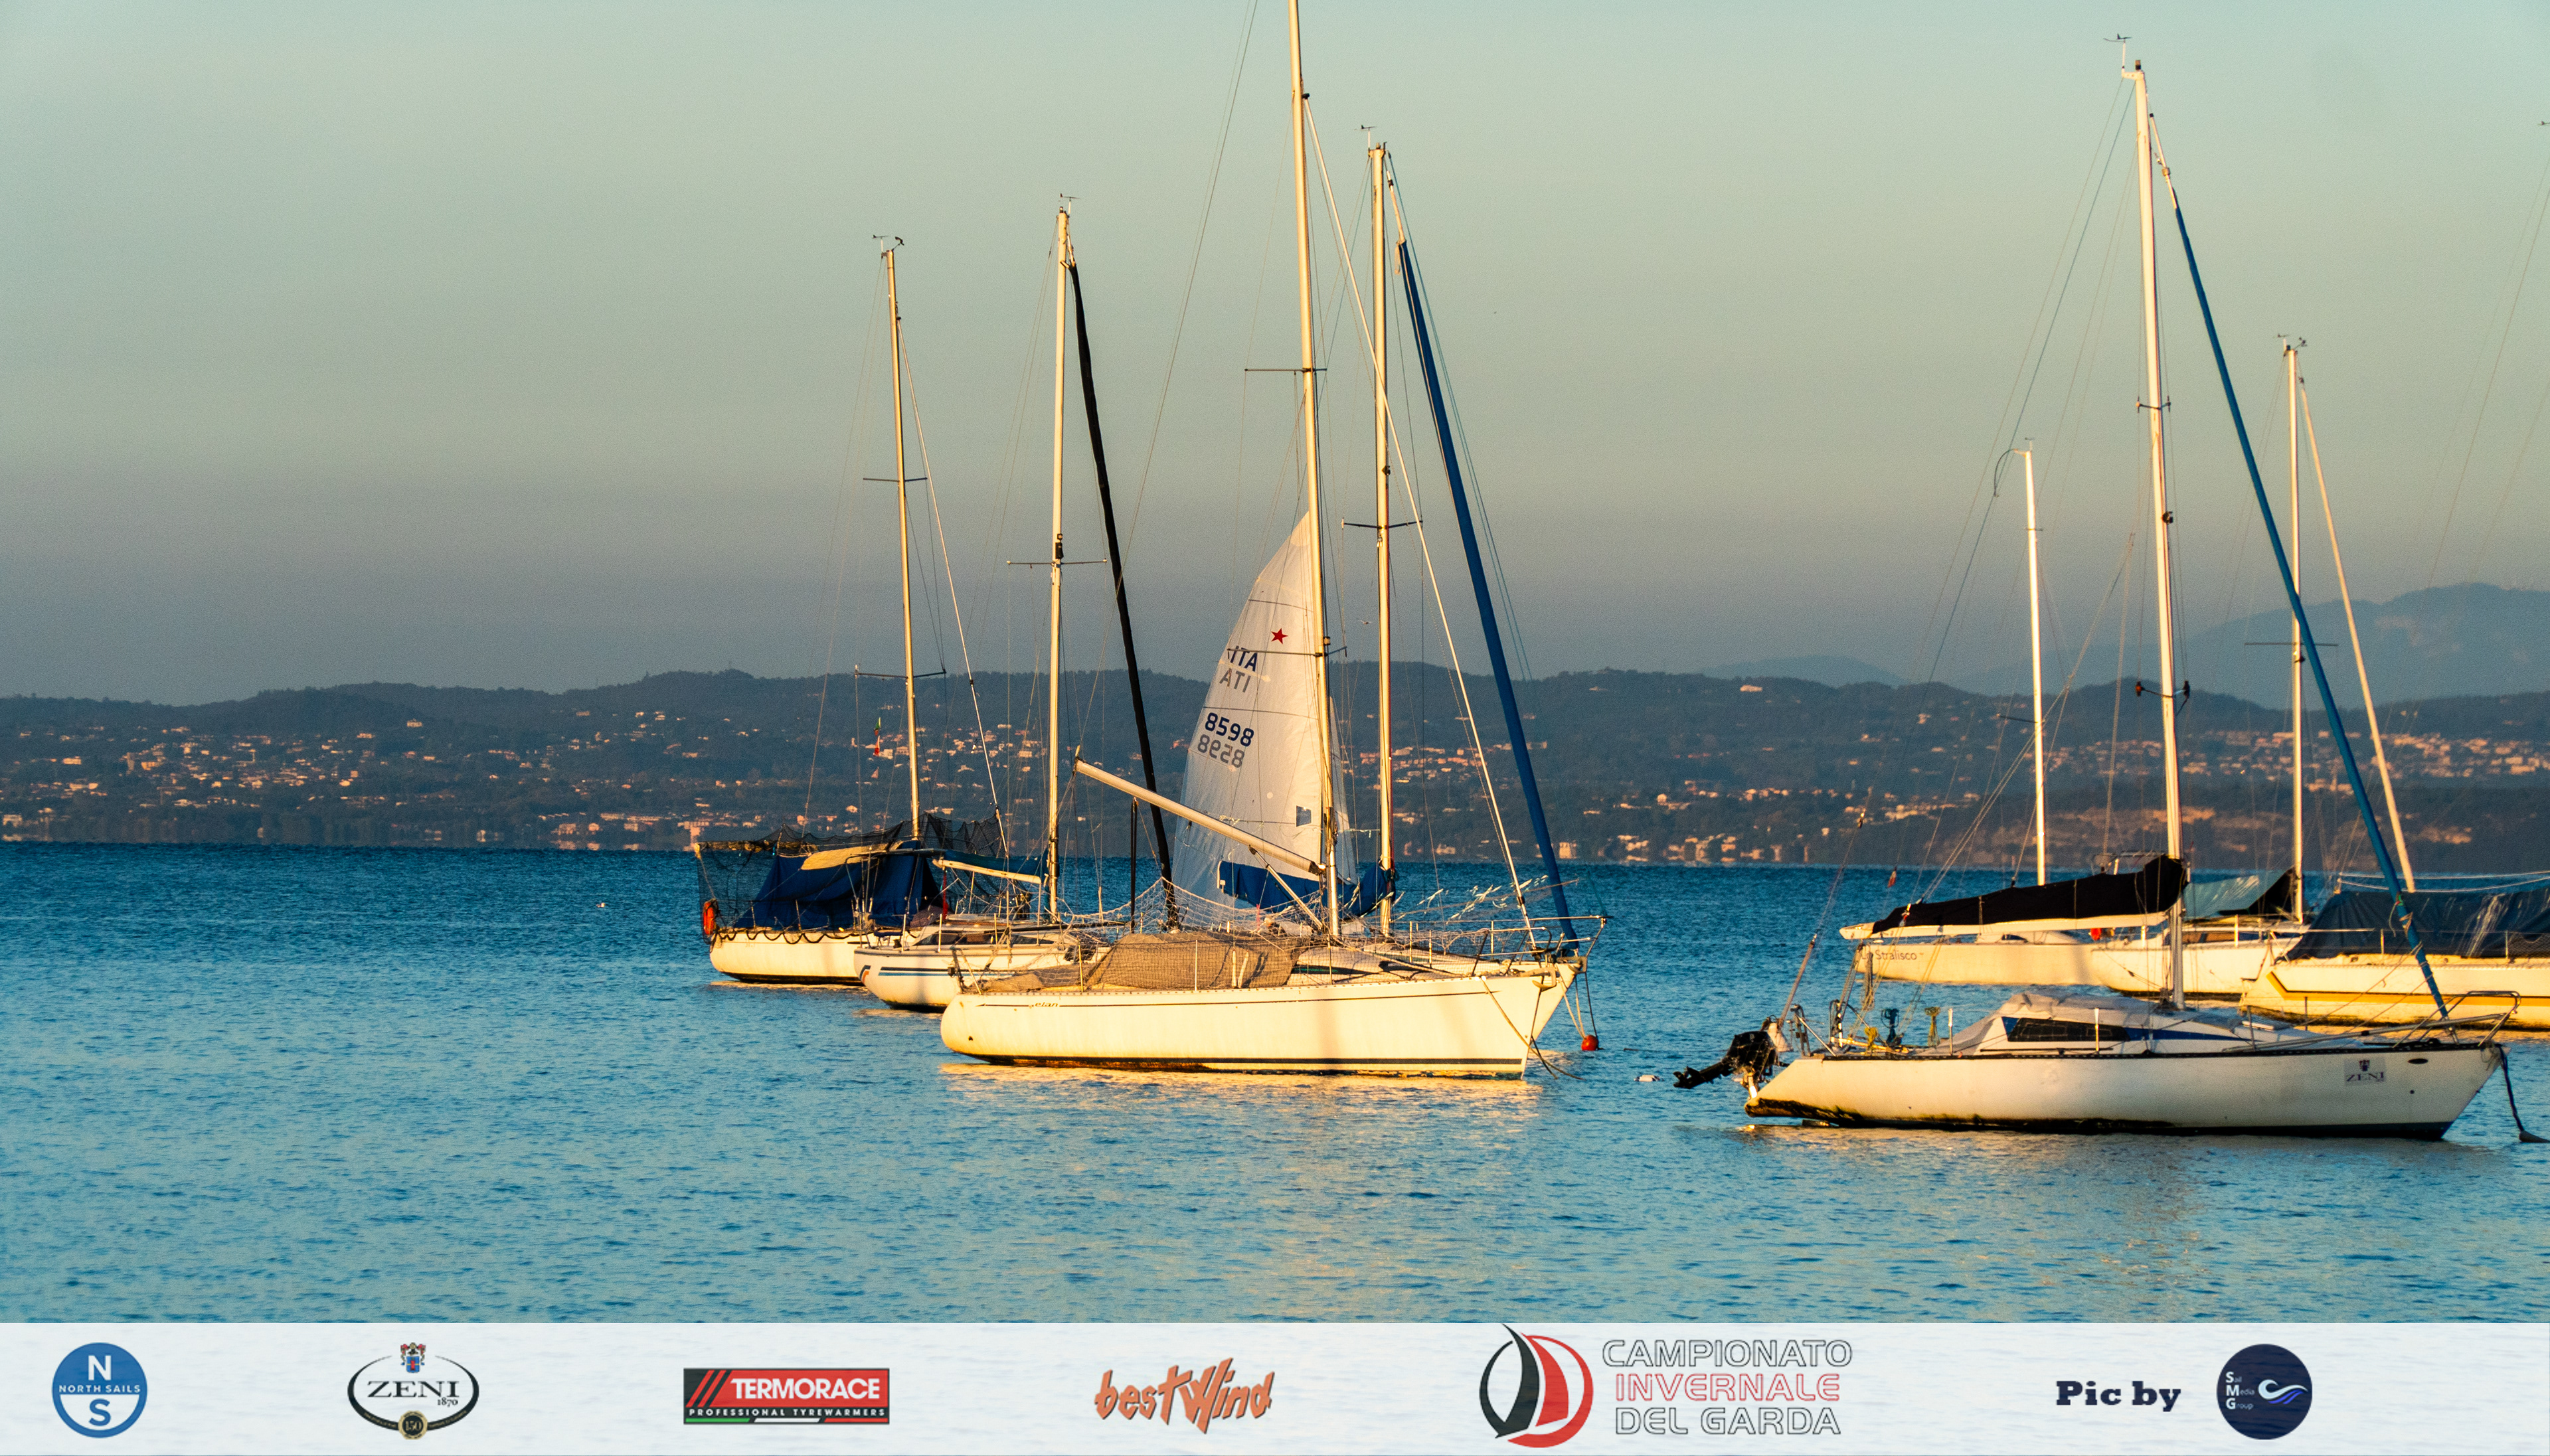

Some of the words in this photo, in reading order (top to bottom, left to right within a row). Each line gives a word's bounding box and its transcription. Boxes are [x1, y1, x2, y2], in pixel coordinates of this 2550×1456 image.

[1230, 645, 1258, 672] ITA
[1205, 712, 1254, 747] 8598
[1875, 949, 1917, 961] Stralisco
